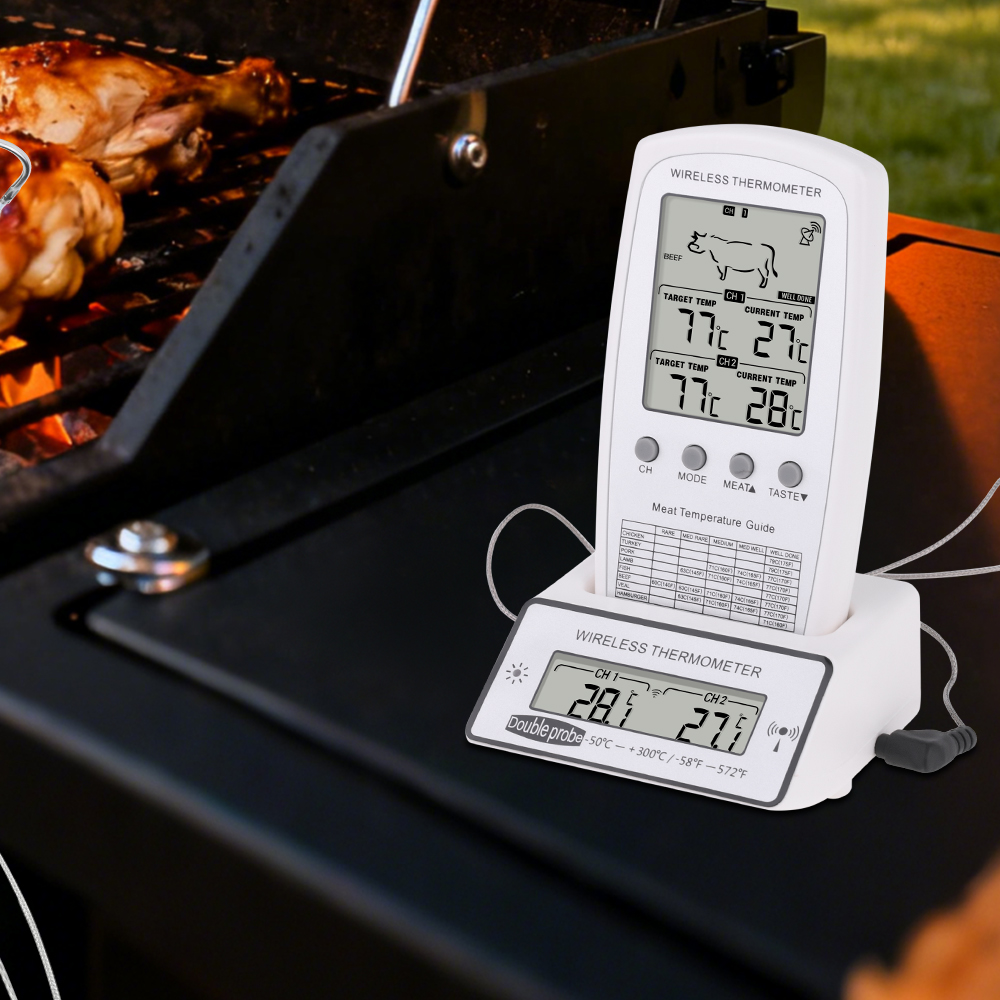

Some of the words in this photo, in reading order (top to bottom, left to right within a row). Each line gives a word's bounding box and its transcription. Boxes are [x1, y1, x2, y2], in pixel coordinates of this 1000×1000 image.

[670, 168, 729, 185] WIRELESS
[732, 176, 822, 198] THERMOMETER
[724, 206, 734, 215] CH
[663, 252, 683, 262] BEEF
[663, 292, 693, 304] TARGET
[696, 297, 717, 308] TEMP
[726, 291, 738, 301] CH
[781, 292, 796, 301] WELL
[796, 294, 813, 303] DONE
[744, 306, 781, 318] CURRENT
[783, 311, 805, 321] TEMP
[655, 357, 685, 369] TARGET
[688, 362, 709, 373] TEMP
[736, 371, 772, 383] CURRENT
[776, 377, 797, 387] TEMP
[638, 464, 653, 474] CH
[677, 472, 707, 484] MODE
[723, 480, 750, 493] MEAT
[768, 488, 800, 501] TASTE
[652, 502, 677, 516] Meat
[680, 507, 742, 528] Temperature
[746, 520, 775, 534] Guide
[622, 530, 644, 539] CHICKEN
[621, 539, 641, 547] TURKEY
[713, 539, 734, 547] MEDIUM
[617, 591, 648, 600] HAMBURGER
[576, 629, 648, 654] WIRELESS
[651, 644, 762, 679] THERMOMETER
[594, 668, 611, 680] CH
[507, 715, 549, 737] Double
[546, 728, 584, 743] probe
[585, 735, 613, 749] -50°C
[676, 756, 703, 769] -58°F
[717, 764, 748, 779] 572°F
